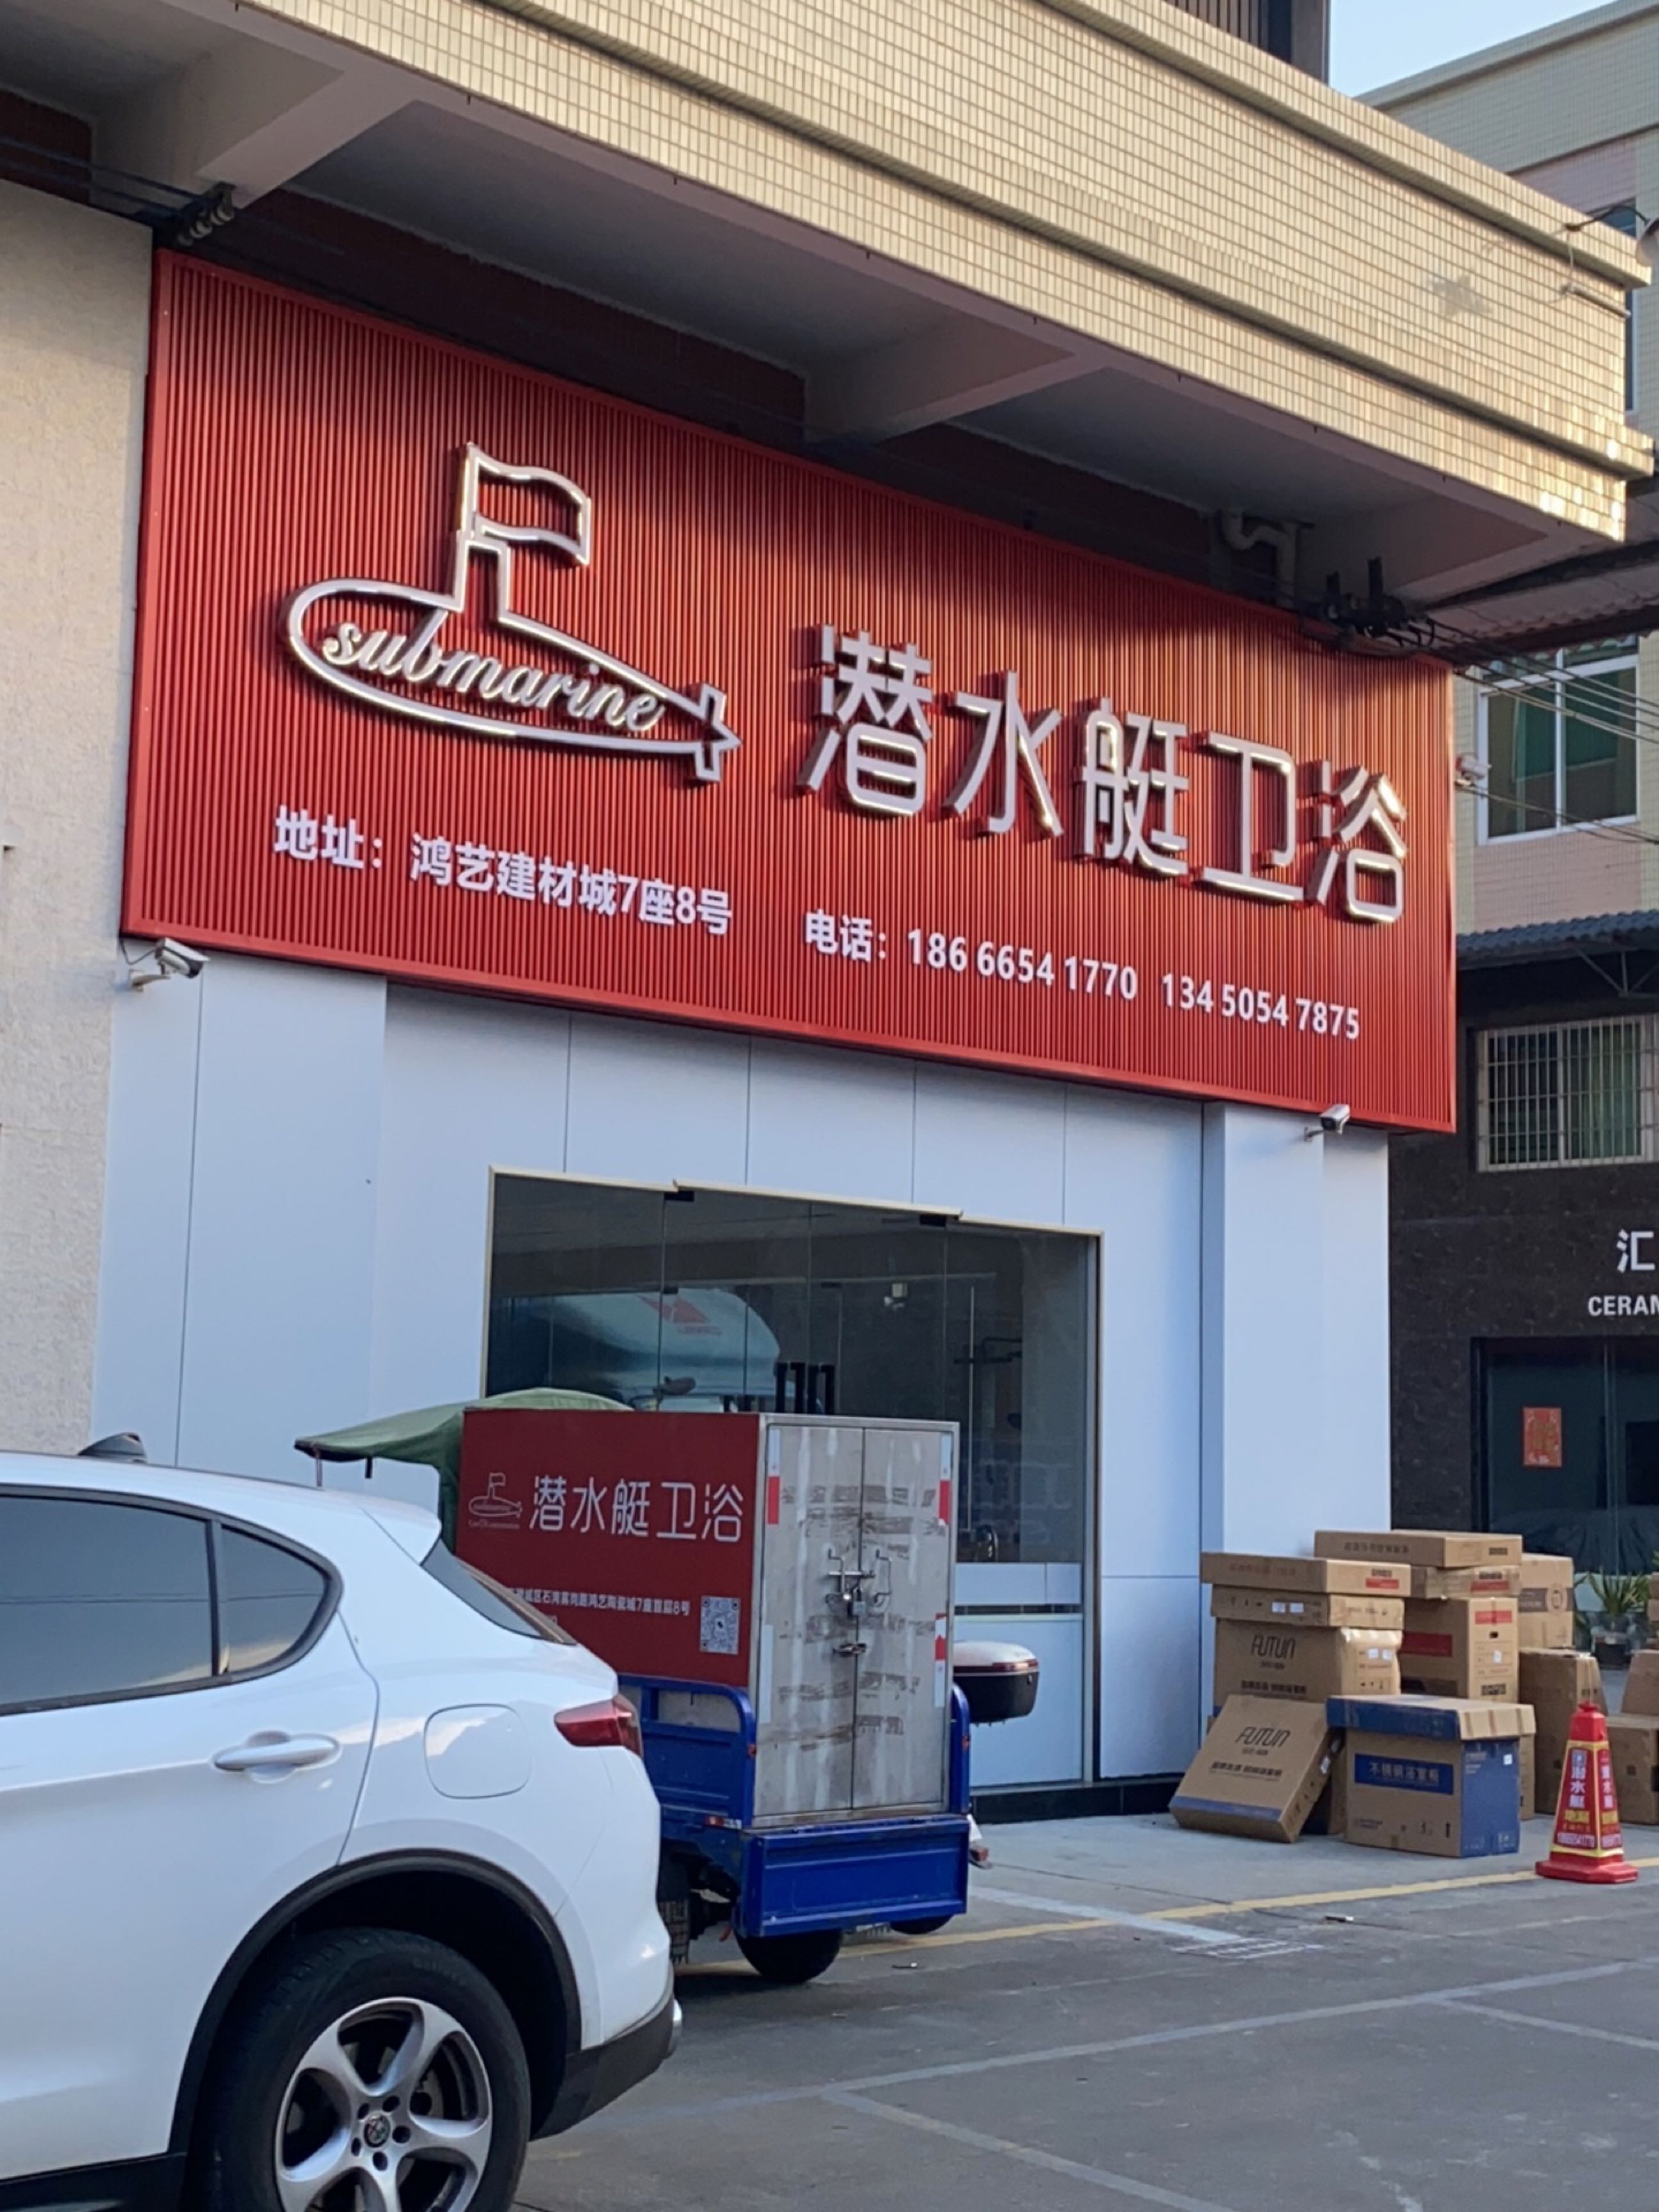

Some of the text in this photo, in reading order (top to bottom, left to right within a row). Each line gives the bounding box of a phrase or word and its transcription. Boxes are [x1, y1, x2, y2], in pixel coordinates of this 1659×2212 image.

[322, 609, 668, 733] submarine
[797, 624, 1407, 924] 潜水艇卫浴
[410, 833, 733, 936] 鸿艺建材城7座8号
[908, 928, 968, 973] 186
[976, 940, 1054, 988] 6654
[1064, 955, 1137, 1000] 1770
[1162, 973, 1214, 1014] 134
[1221, 982, 1289, 1028] 5054
[1295, 997, 1360, 1039] 7875
[1617, 1228, 1656, 1273] 汇
[529, 1474, 744, 1543] 潜水艇卫浴
